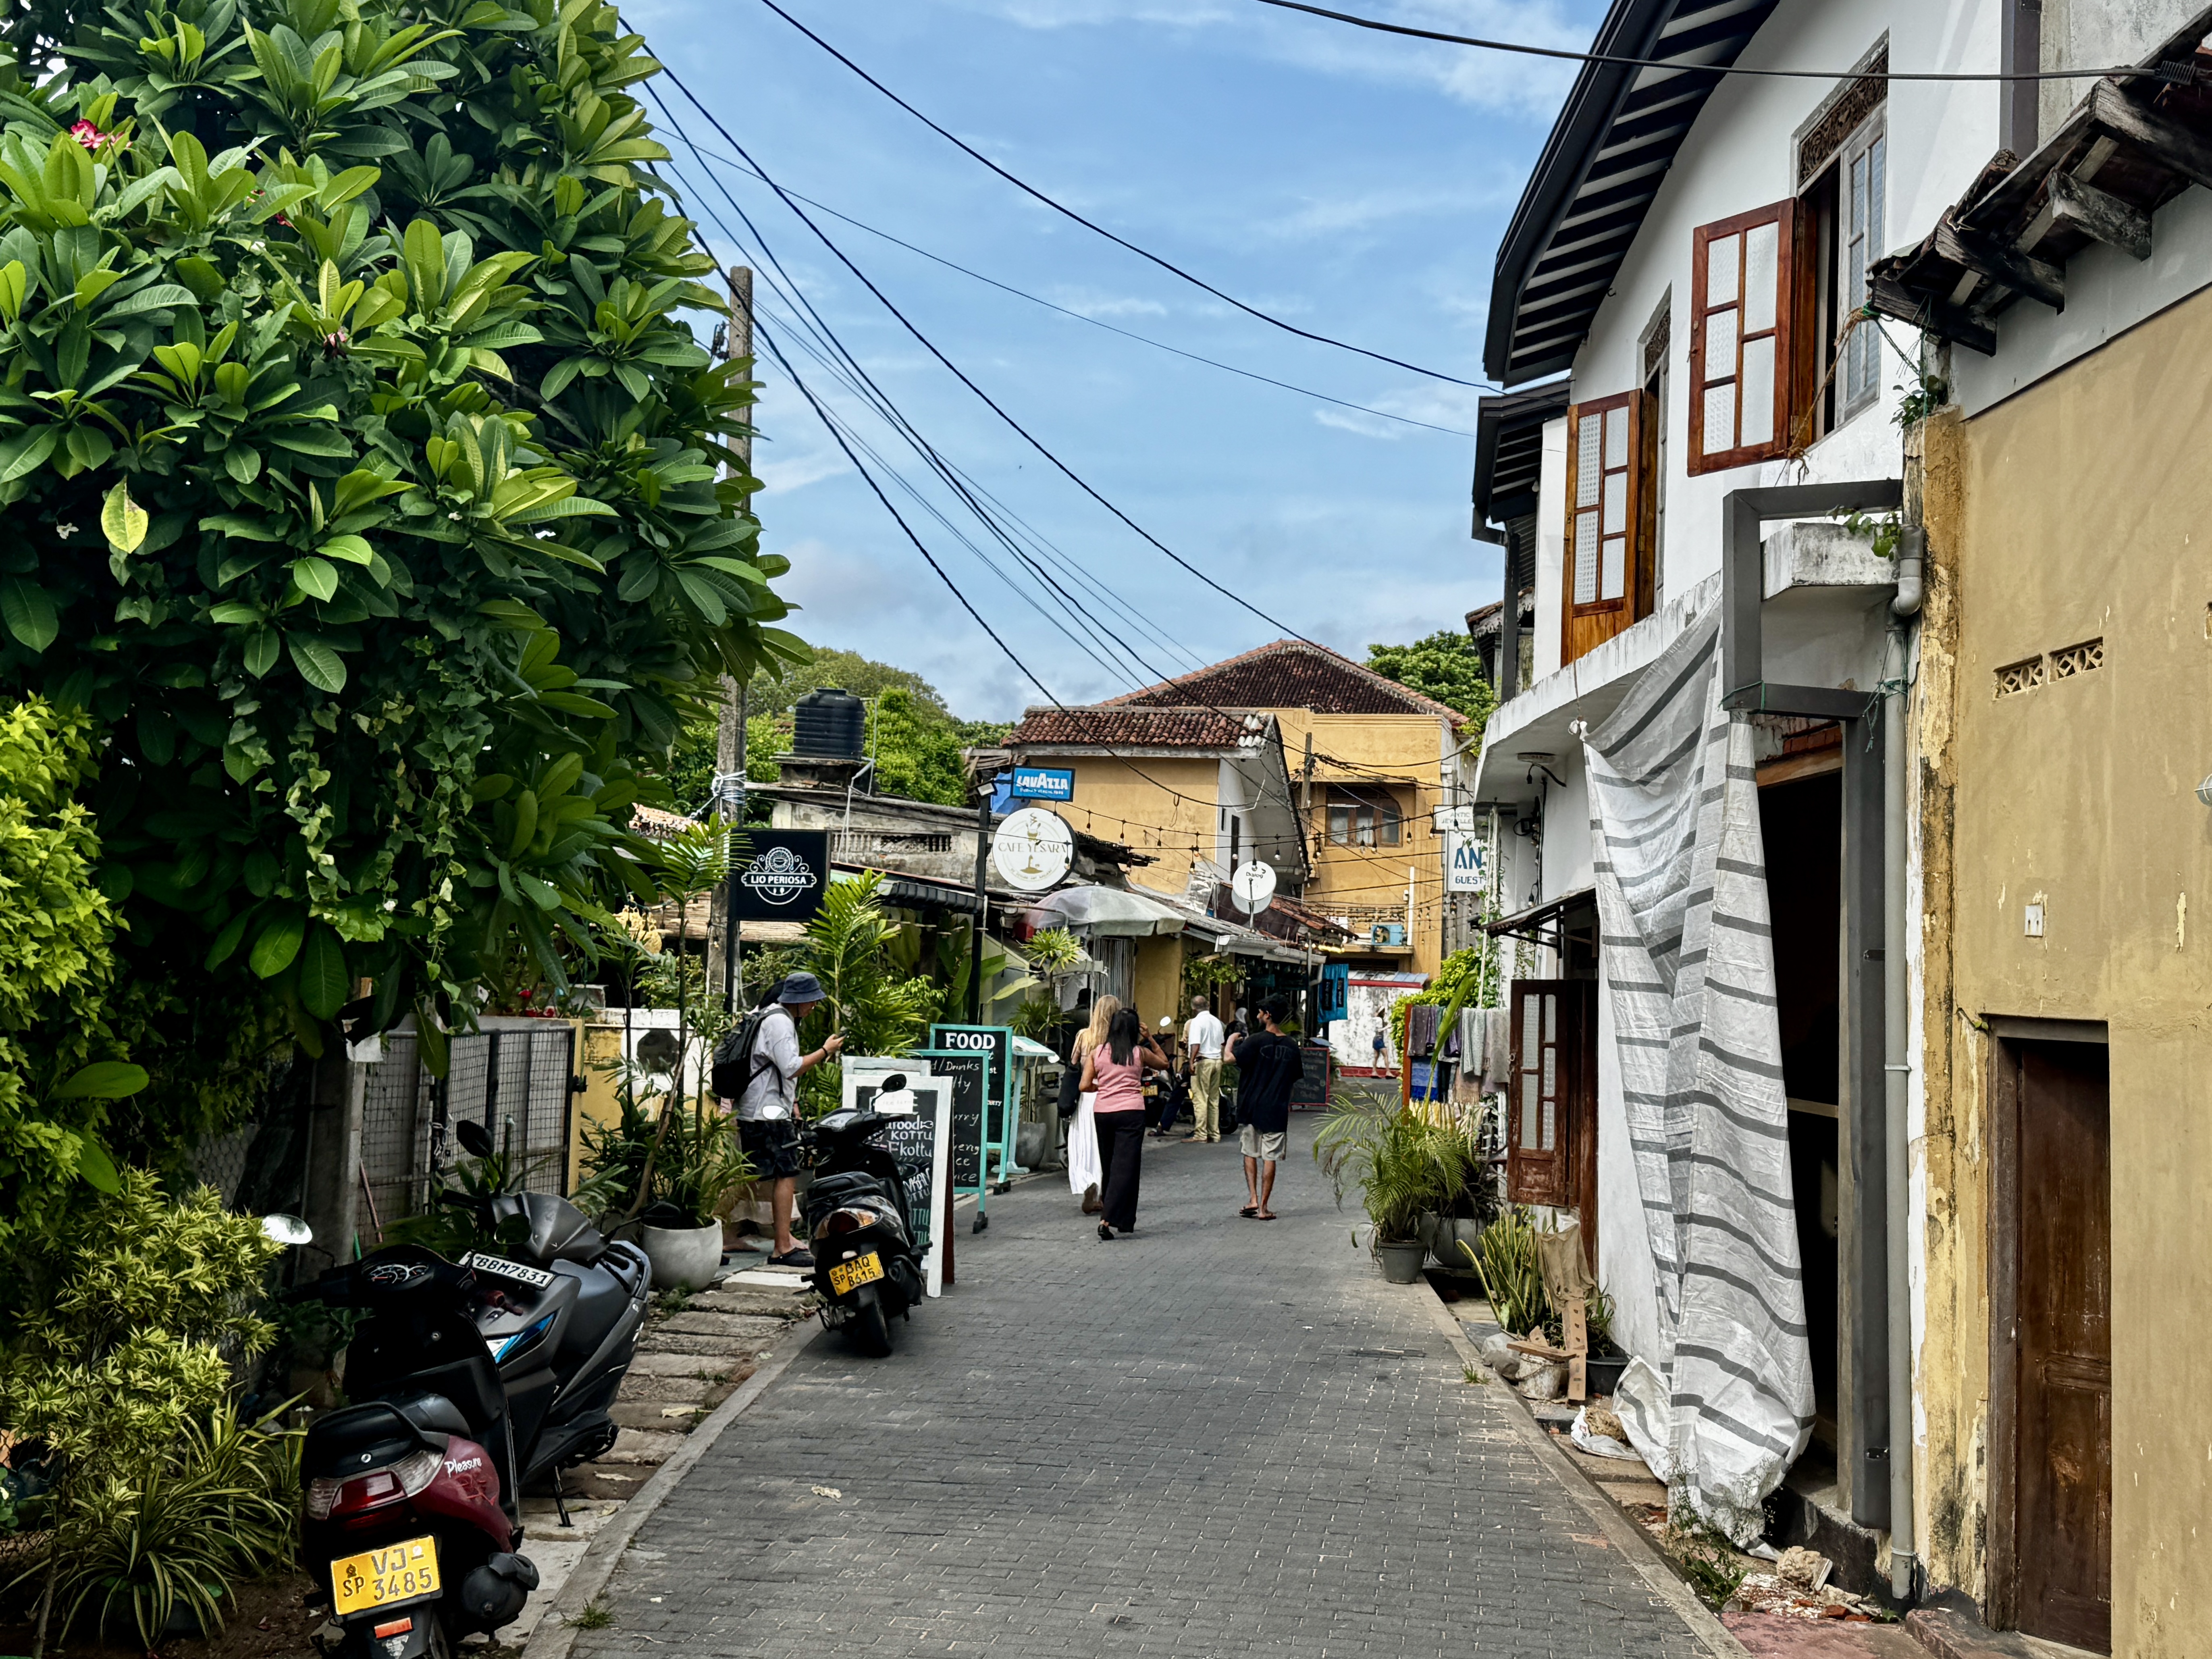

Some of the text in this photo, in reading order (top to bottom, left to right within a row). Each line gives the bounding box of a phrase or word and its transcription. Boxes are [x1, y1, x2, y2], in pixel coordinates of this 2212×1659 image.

[1016, 773, 1068, 790] LAVAZZA
[998, 842, 1024, 852] CAFE
[751, 875, 807, 884] LIO PERIOSA
[1455, 875, 1482, 885] GUEST
[946, 1033, 996, 1050] FOOD
[476, 1257, 548, 1285] BBM7831
[846, 1256, 871, 1274] BAQ
[834, 1268, 875, 1287] SP 8615
[444, 1457, 482, 1478] Pleasure
[343, 1567, 432, 1601] SP 3485
